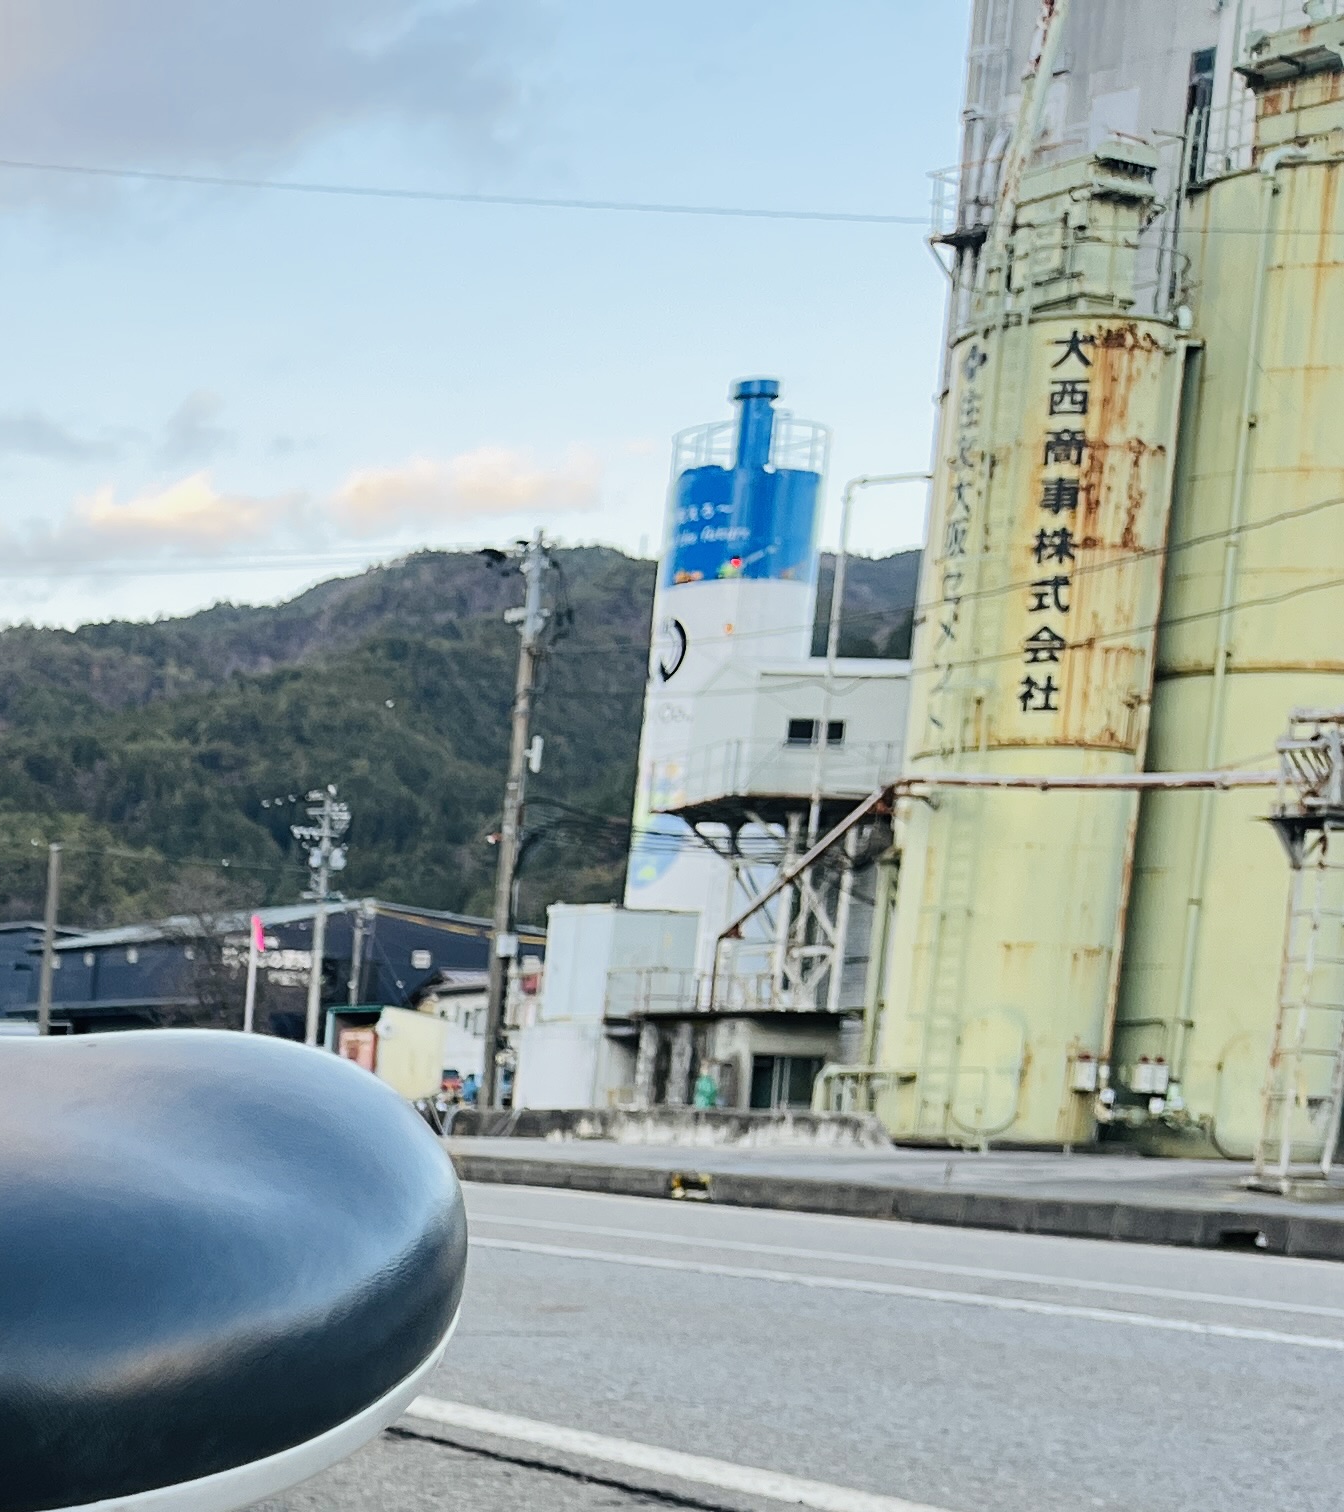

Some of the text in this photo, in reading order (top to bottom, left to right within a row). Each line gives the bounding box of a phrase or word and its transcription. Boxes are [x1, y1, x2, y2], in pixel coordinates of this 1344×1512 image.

[1018, 330, 1094, 713] 大西商事株式会社
